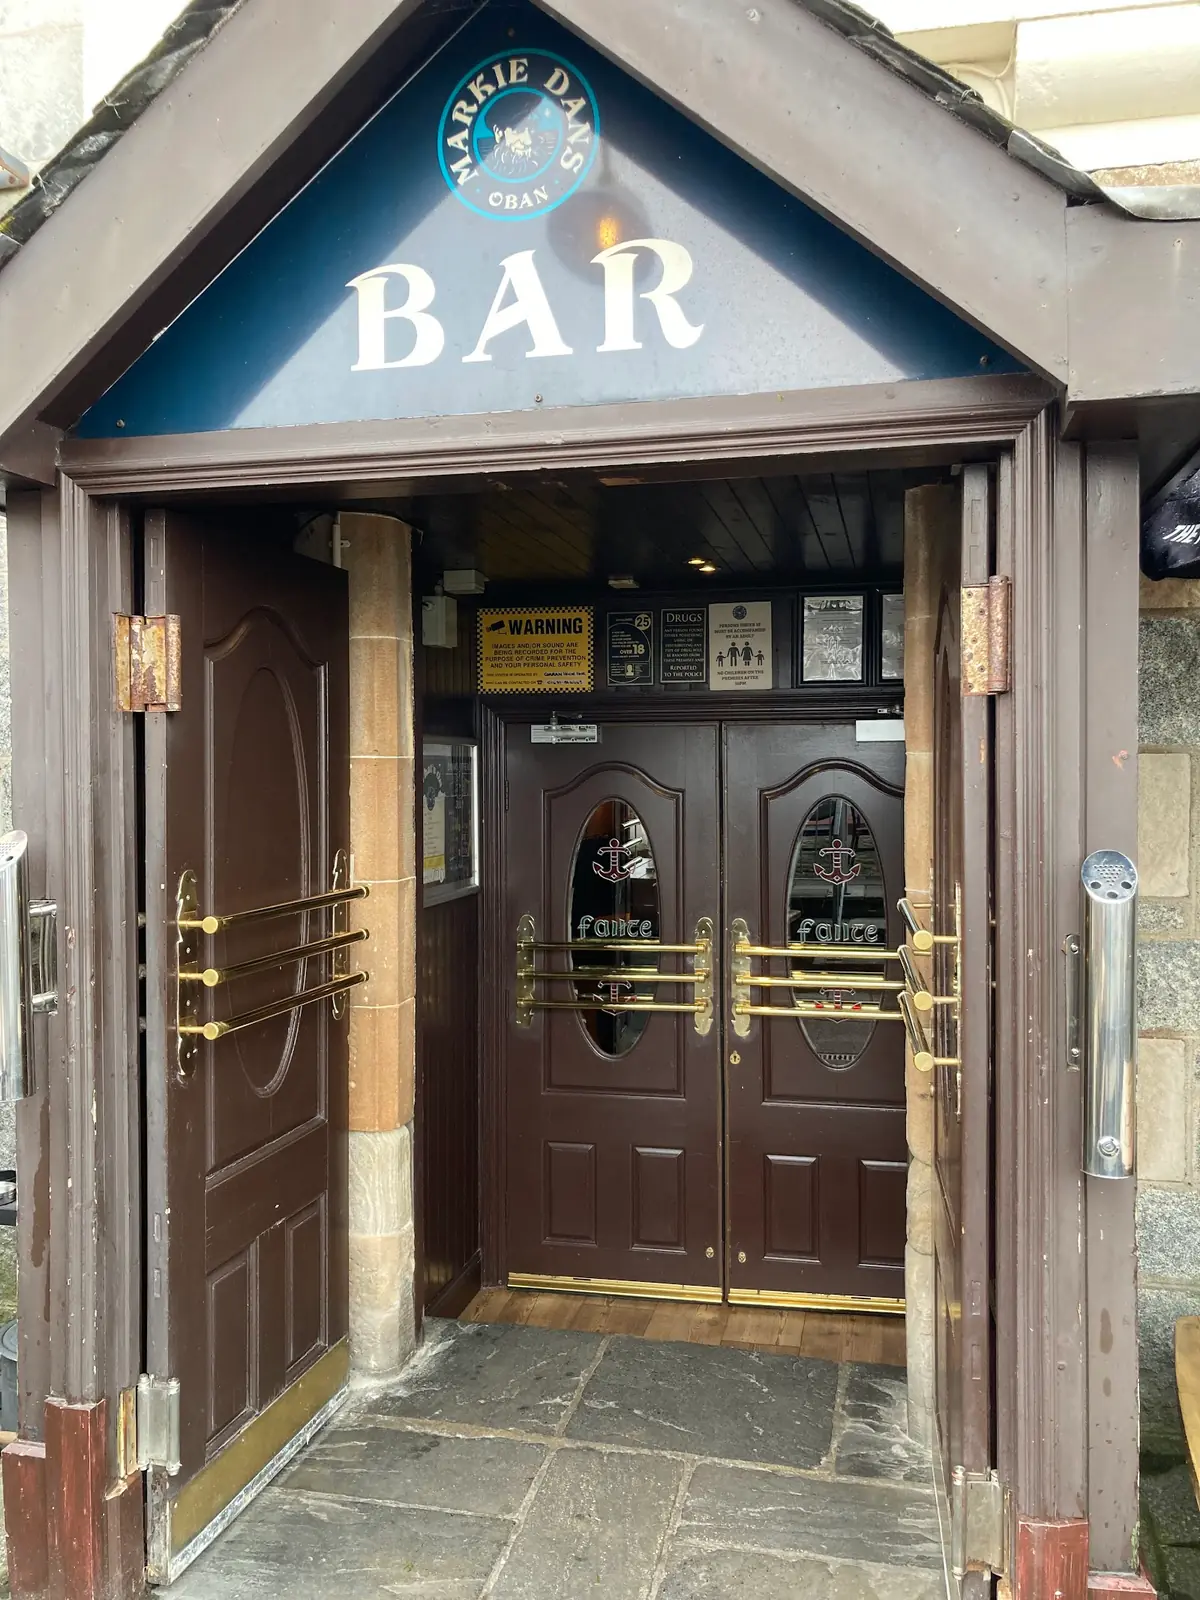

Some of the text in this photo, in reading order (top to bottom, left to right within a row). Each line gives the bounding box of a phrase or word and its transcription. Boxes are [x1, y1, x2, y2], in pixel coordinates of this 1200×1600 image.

[447, 58, 592, 186] MARKIE DANS
[488, 185, 549, 209] OBAN
[344, 238, 705, 371] BAR
[636, 617, 650, 627] 25
[666, 612, 702, 623] DRUGS
[508, 618, 583, 635] WARNING
[632, 644, 646, 655] 18
